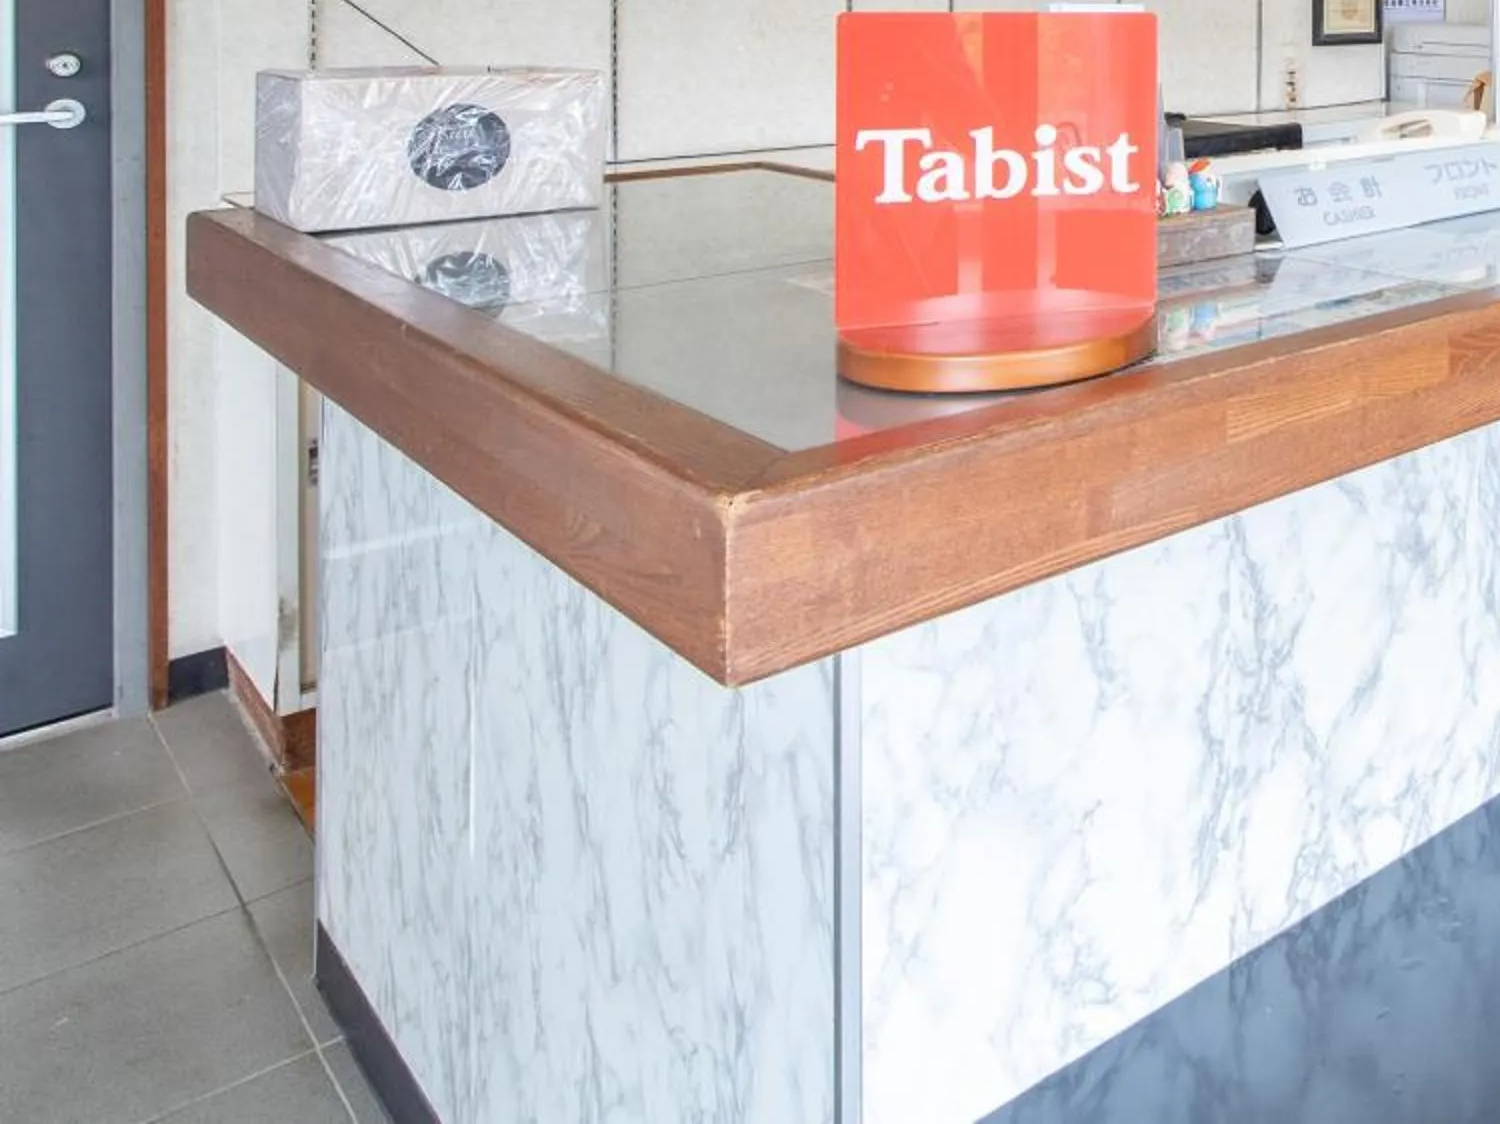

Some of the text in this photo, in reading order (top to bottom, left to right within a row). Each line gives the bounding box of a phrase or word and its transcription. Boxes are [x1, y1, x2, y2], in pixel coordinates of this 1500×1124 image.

[855, 124, 1141, 204] Tabist
[1423, 157, 1498, 186] フロント
[1294, 175, 1382, 207] お会計
[1322, 205, 1376, 226] CASHIER
